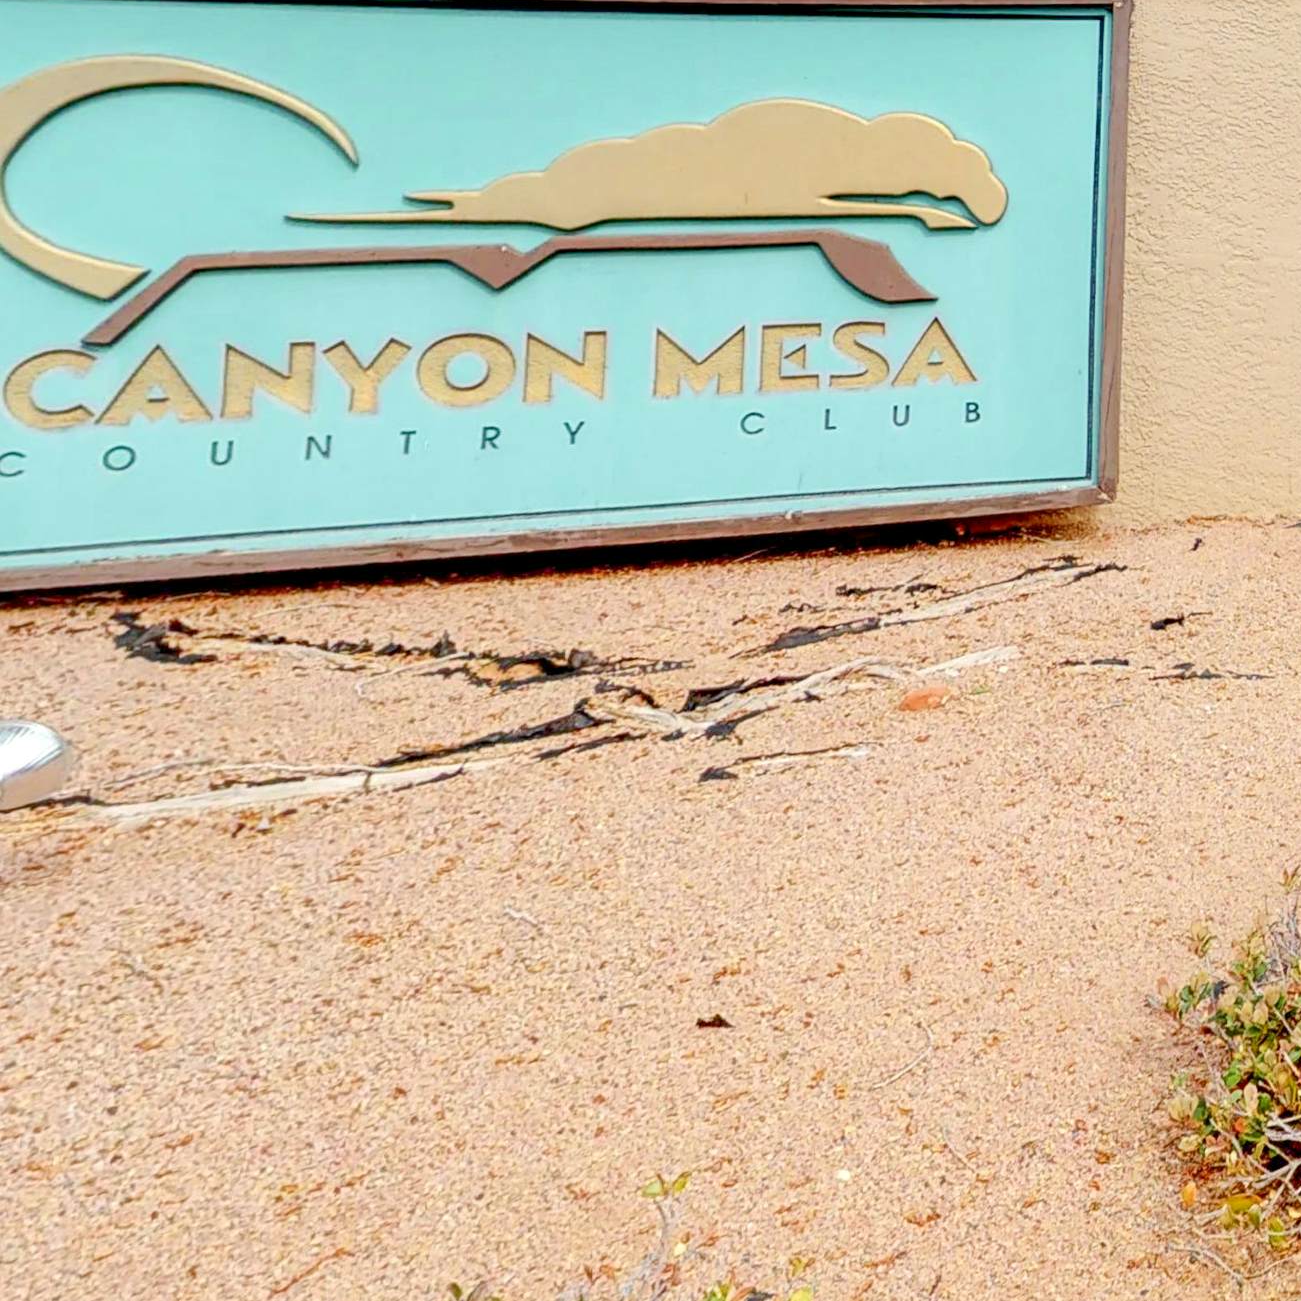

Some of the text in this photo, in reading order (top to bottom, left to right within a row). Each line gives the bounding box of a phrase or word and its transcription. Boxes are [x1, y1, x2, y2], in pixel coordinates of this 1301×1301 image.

[3, 317, 978, 430] CANYON MESA
[0, 402, 981, 477] COUNTRY CLUB
